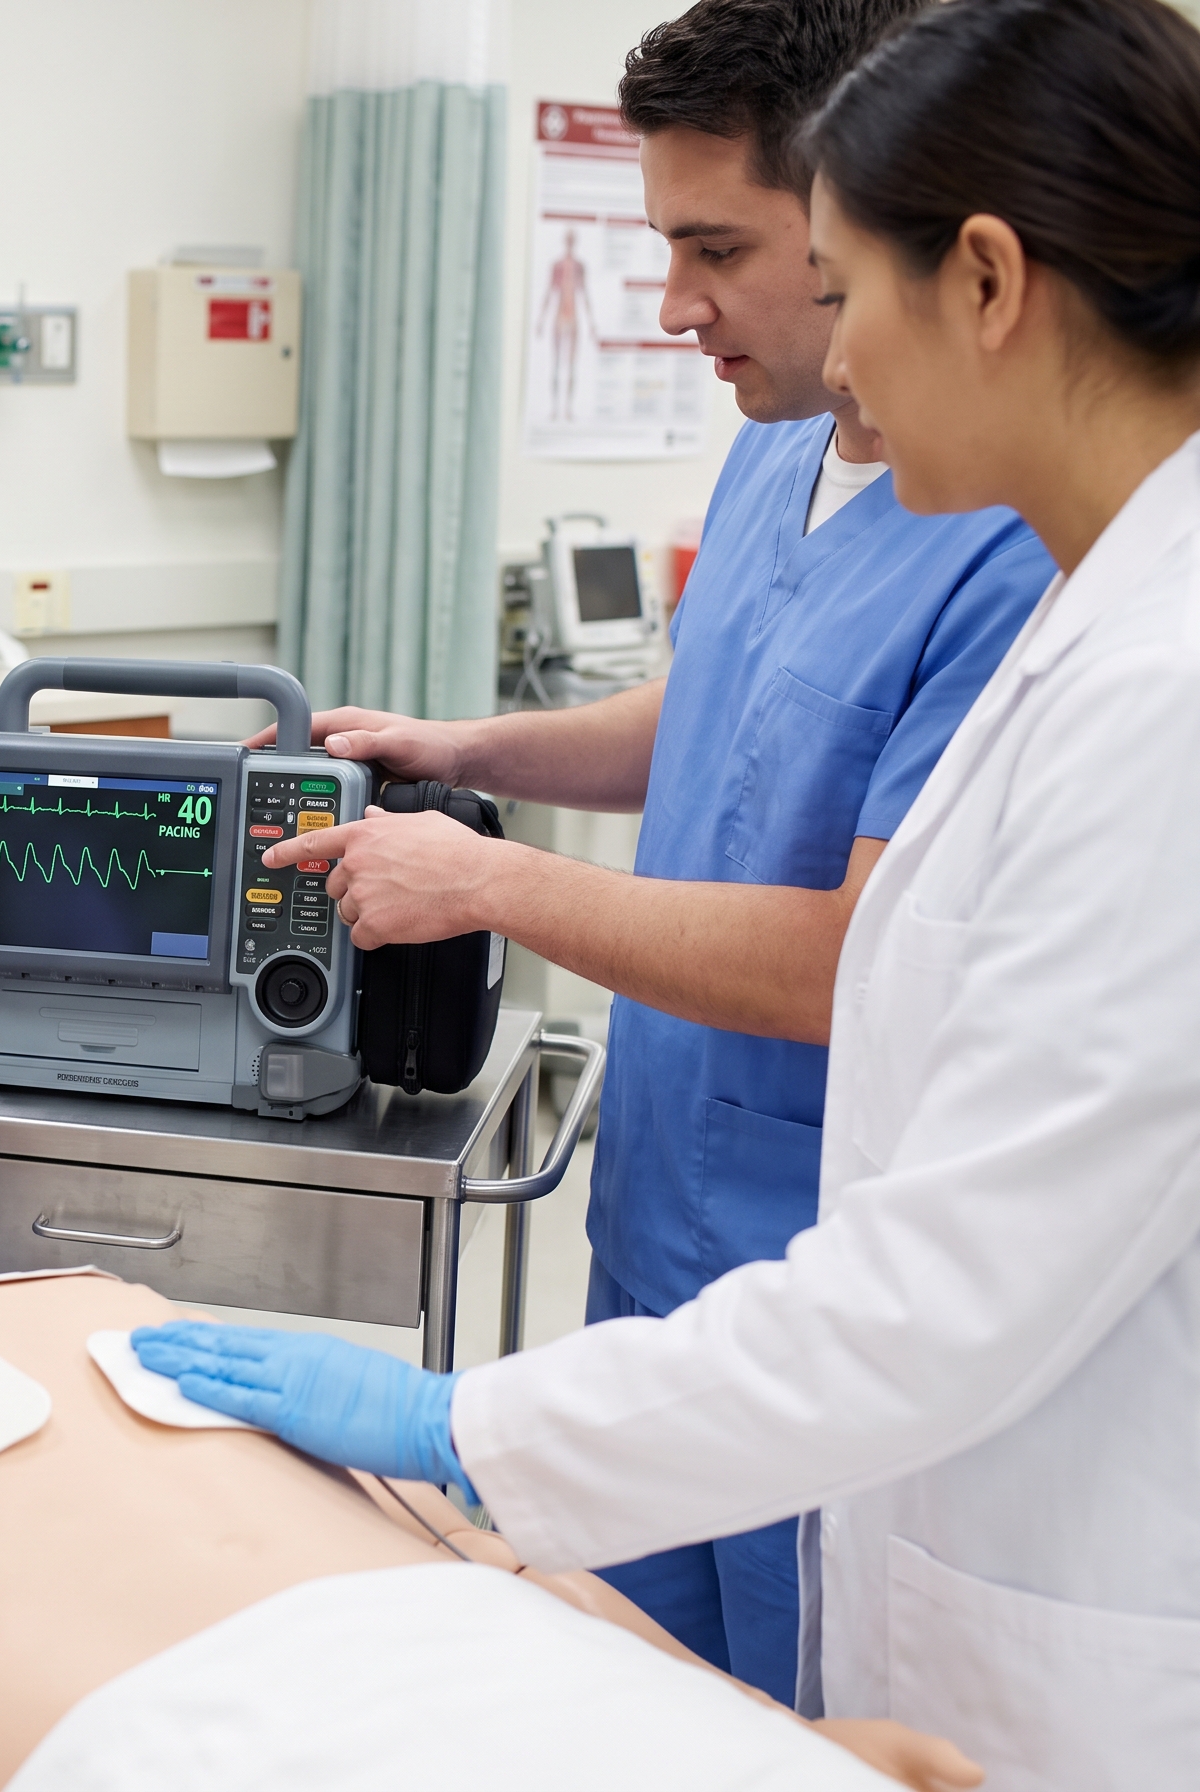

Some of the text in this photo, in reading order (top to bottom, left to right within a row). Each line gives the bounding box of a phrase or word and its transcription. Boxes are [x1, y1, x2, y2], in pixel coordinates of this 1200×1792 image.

[157, 793, 212, 825] HR 40
[158, 824, 201, 839] PACING
